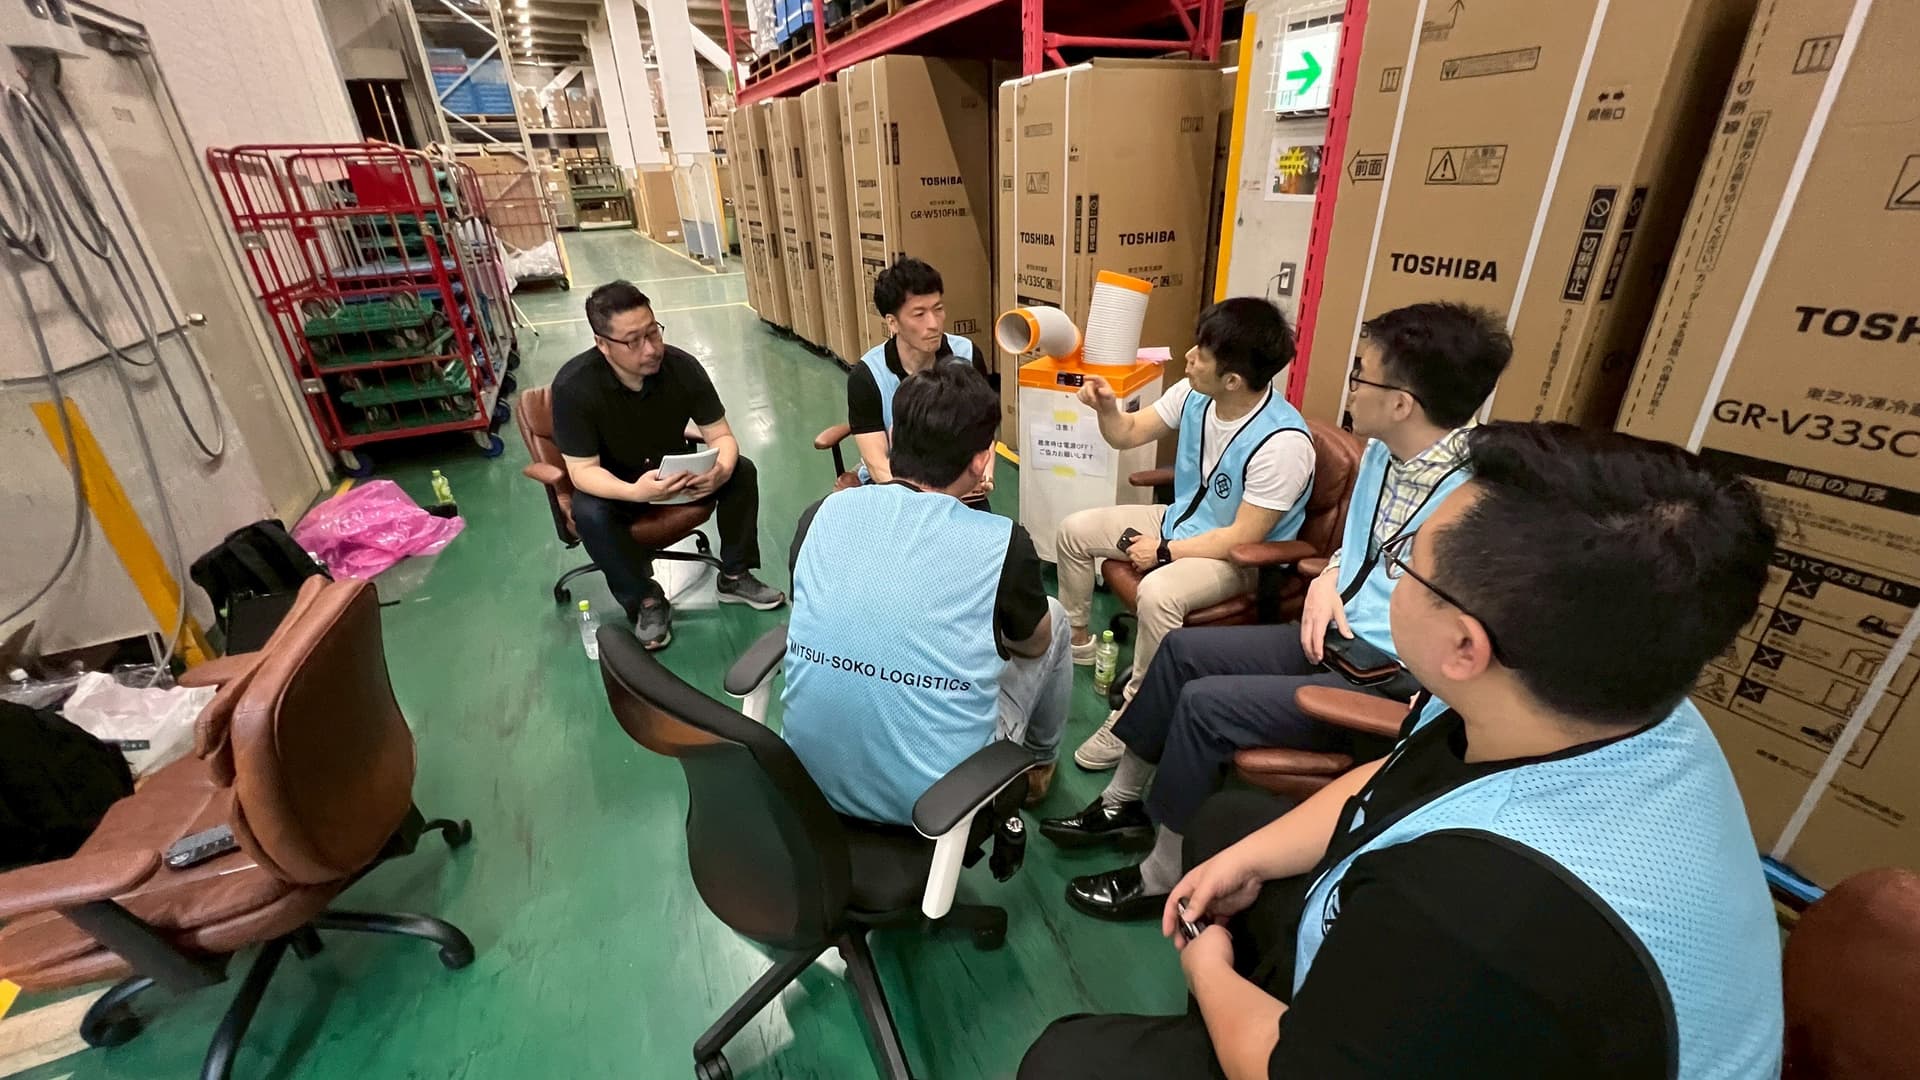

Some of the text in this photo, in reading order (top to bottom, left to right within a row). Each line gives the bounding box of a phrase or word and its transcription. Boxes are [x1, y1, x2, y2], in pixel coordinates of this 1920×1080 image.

[1354, 159, 1382, 176] 前面
[920, 176, 963, 186] TOSHIBA
[1020, 232, 1055, 247] TOSHIBA
[1118, 230, 1176, 246] TOSHIBA
[1390, 252, 1498, 283] TOSHIBA
[1567, 236, 1598, 295] 切断禁止
[790, 642, 971, 692] MITSUI-SOKO LOGISTICS
